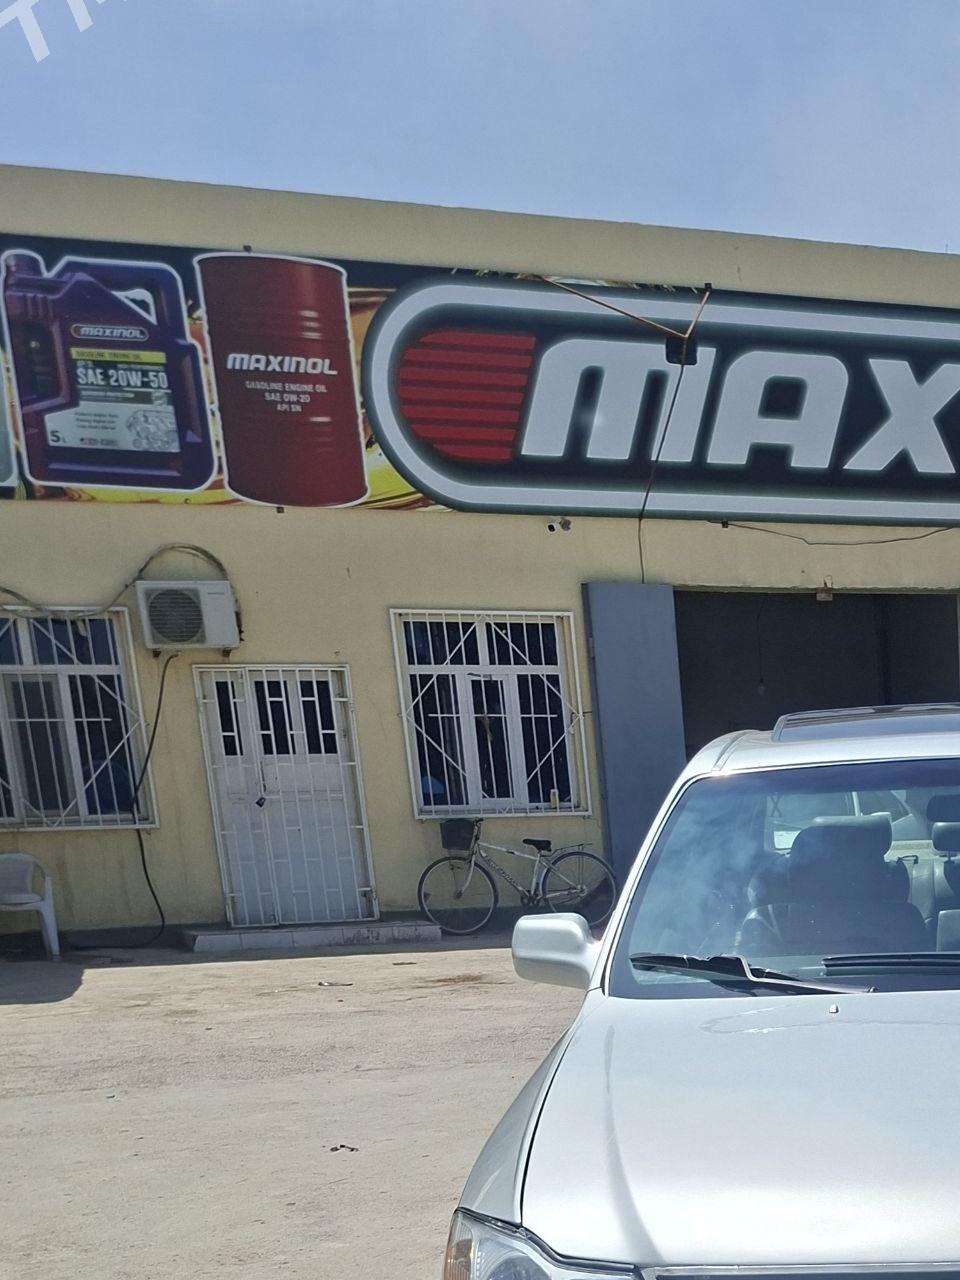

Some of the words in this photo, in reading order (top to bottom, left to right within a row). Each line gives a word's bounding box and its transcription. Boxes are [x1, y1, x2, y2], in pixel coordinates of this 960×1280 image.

[79, 327, 146, 339] MAXINOL
[226, 353, 338, 375] MAXINOL
[76, 368, 105, 385] SAE
[108, 369, 168, 388] 20W-50
